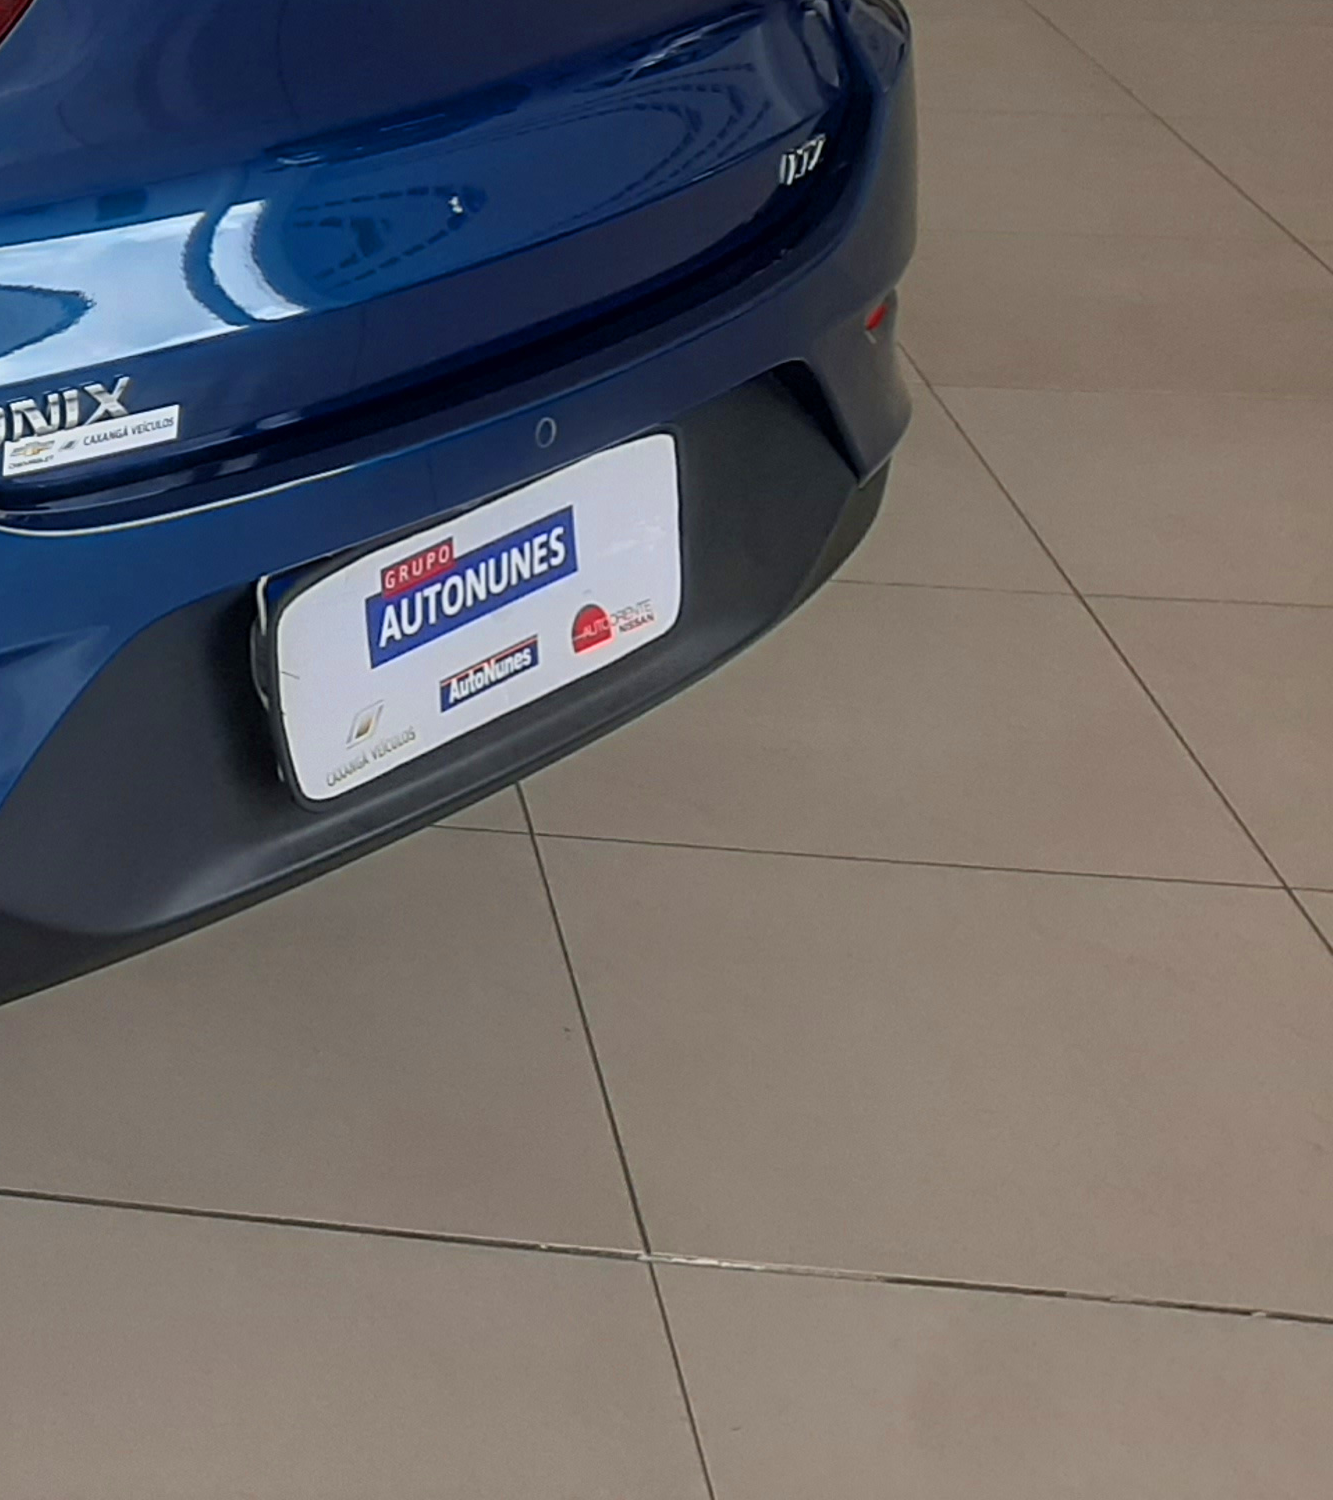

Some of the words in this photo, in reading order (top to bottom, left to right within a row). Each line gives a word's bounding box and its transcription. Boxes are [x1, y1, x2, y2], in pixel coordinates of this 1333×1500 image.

[379, 526, 566, 648] AUTONUNES
[384, 544, 451, 590] GRUPO
[448, 647, 532, 704] AutoNunes
